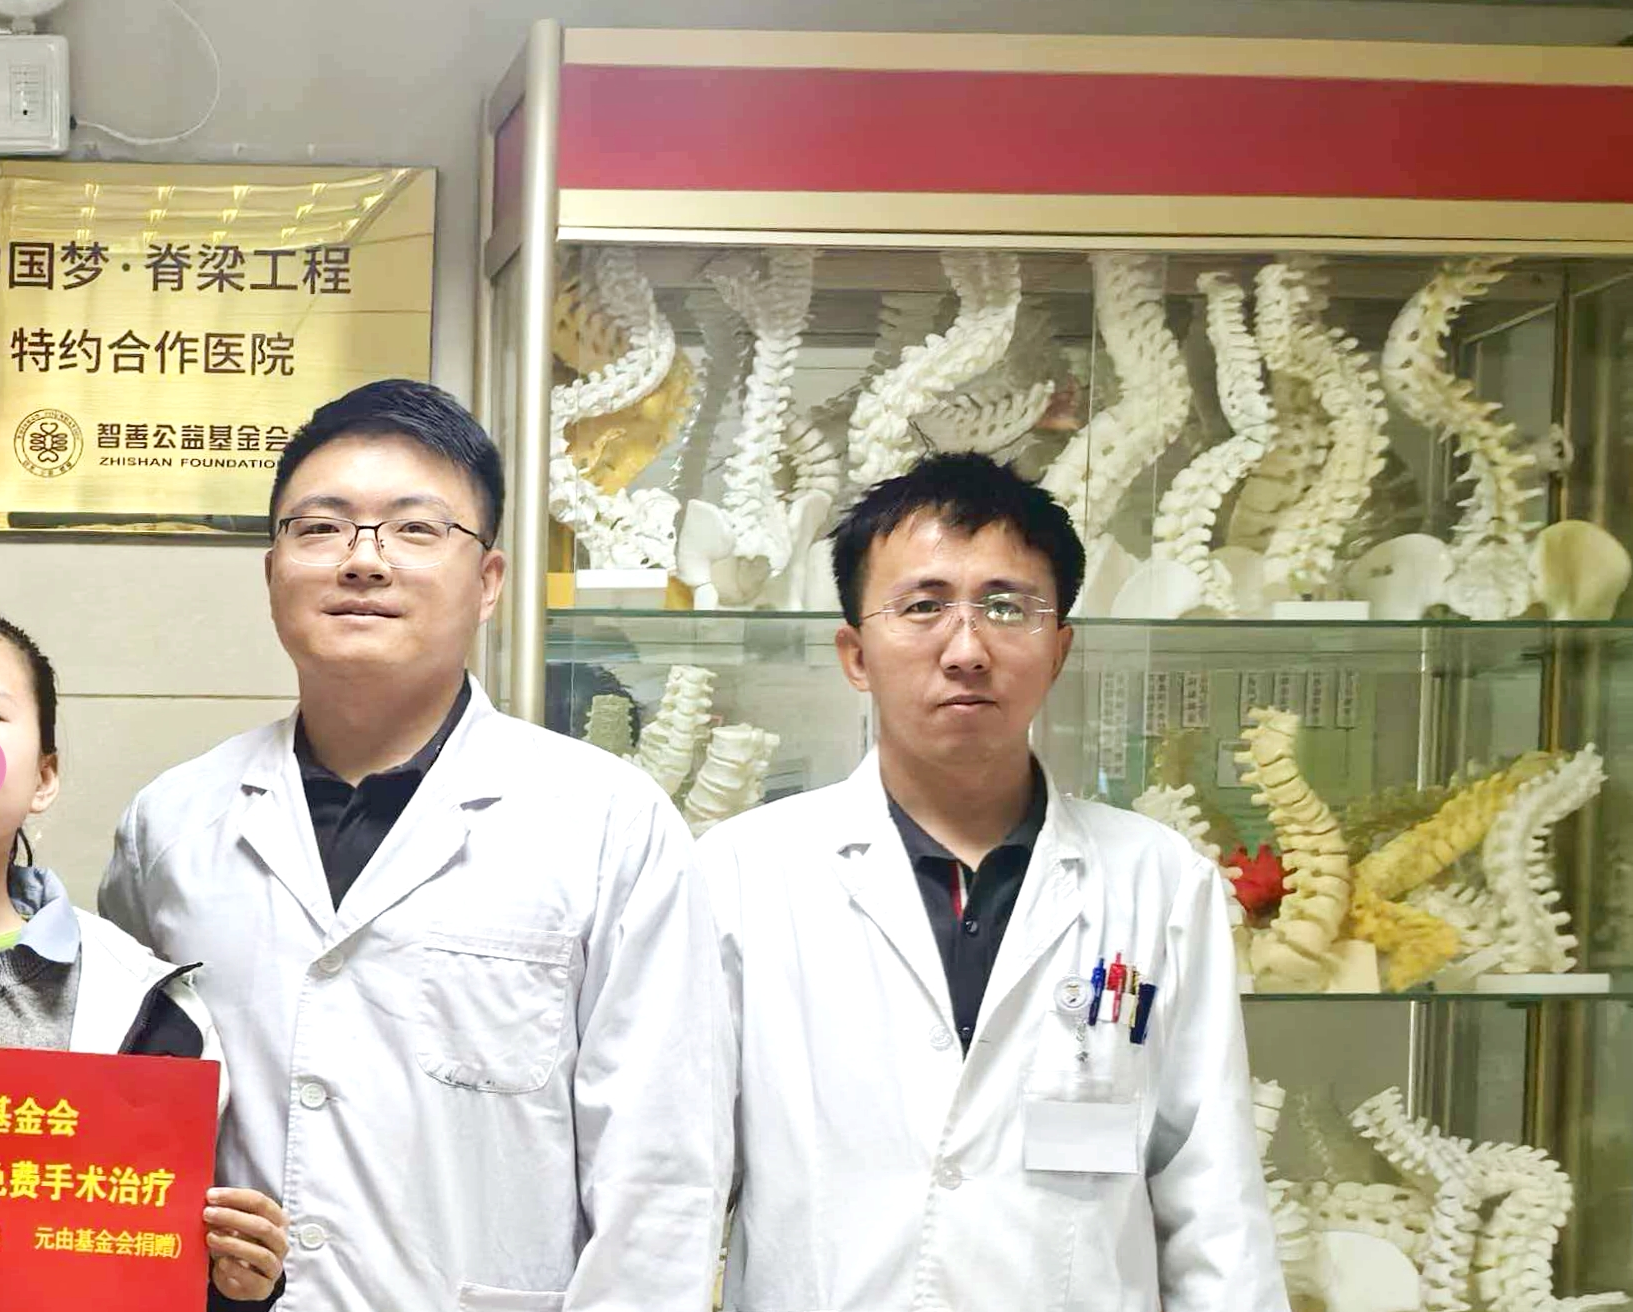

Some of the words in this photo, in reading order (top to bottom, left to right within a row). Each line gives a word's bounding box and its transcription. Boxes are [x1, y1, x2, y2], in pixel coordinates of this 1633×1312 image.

[9, 326, 296, 377] 特约合作医院
[97, 422, 289, 452] 智善公益基金会
[99, 456, 173, 468] ZHISHAN
[180, 457, 276, 469] FOUNDATIO
